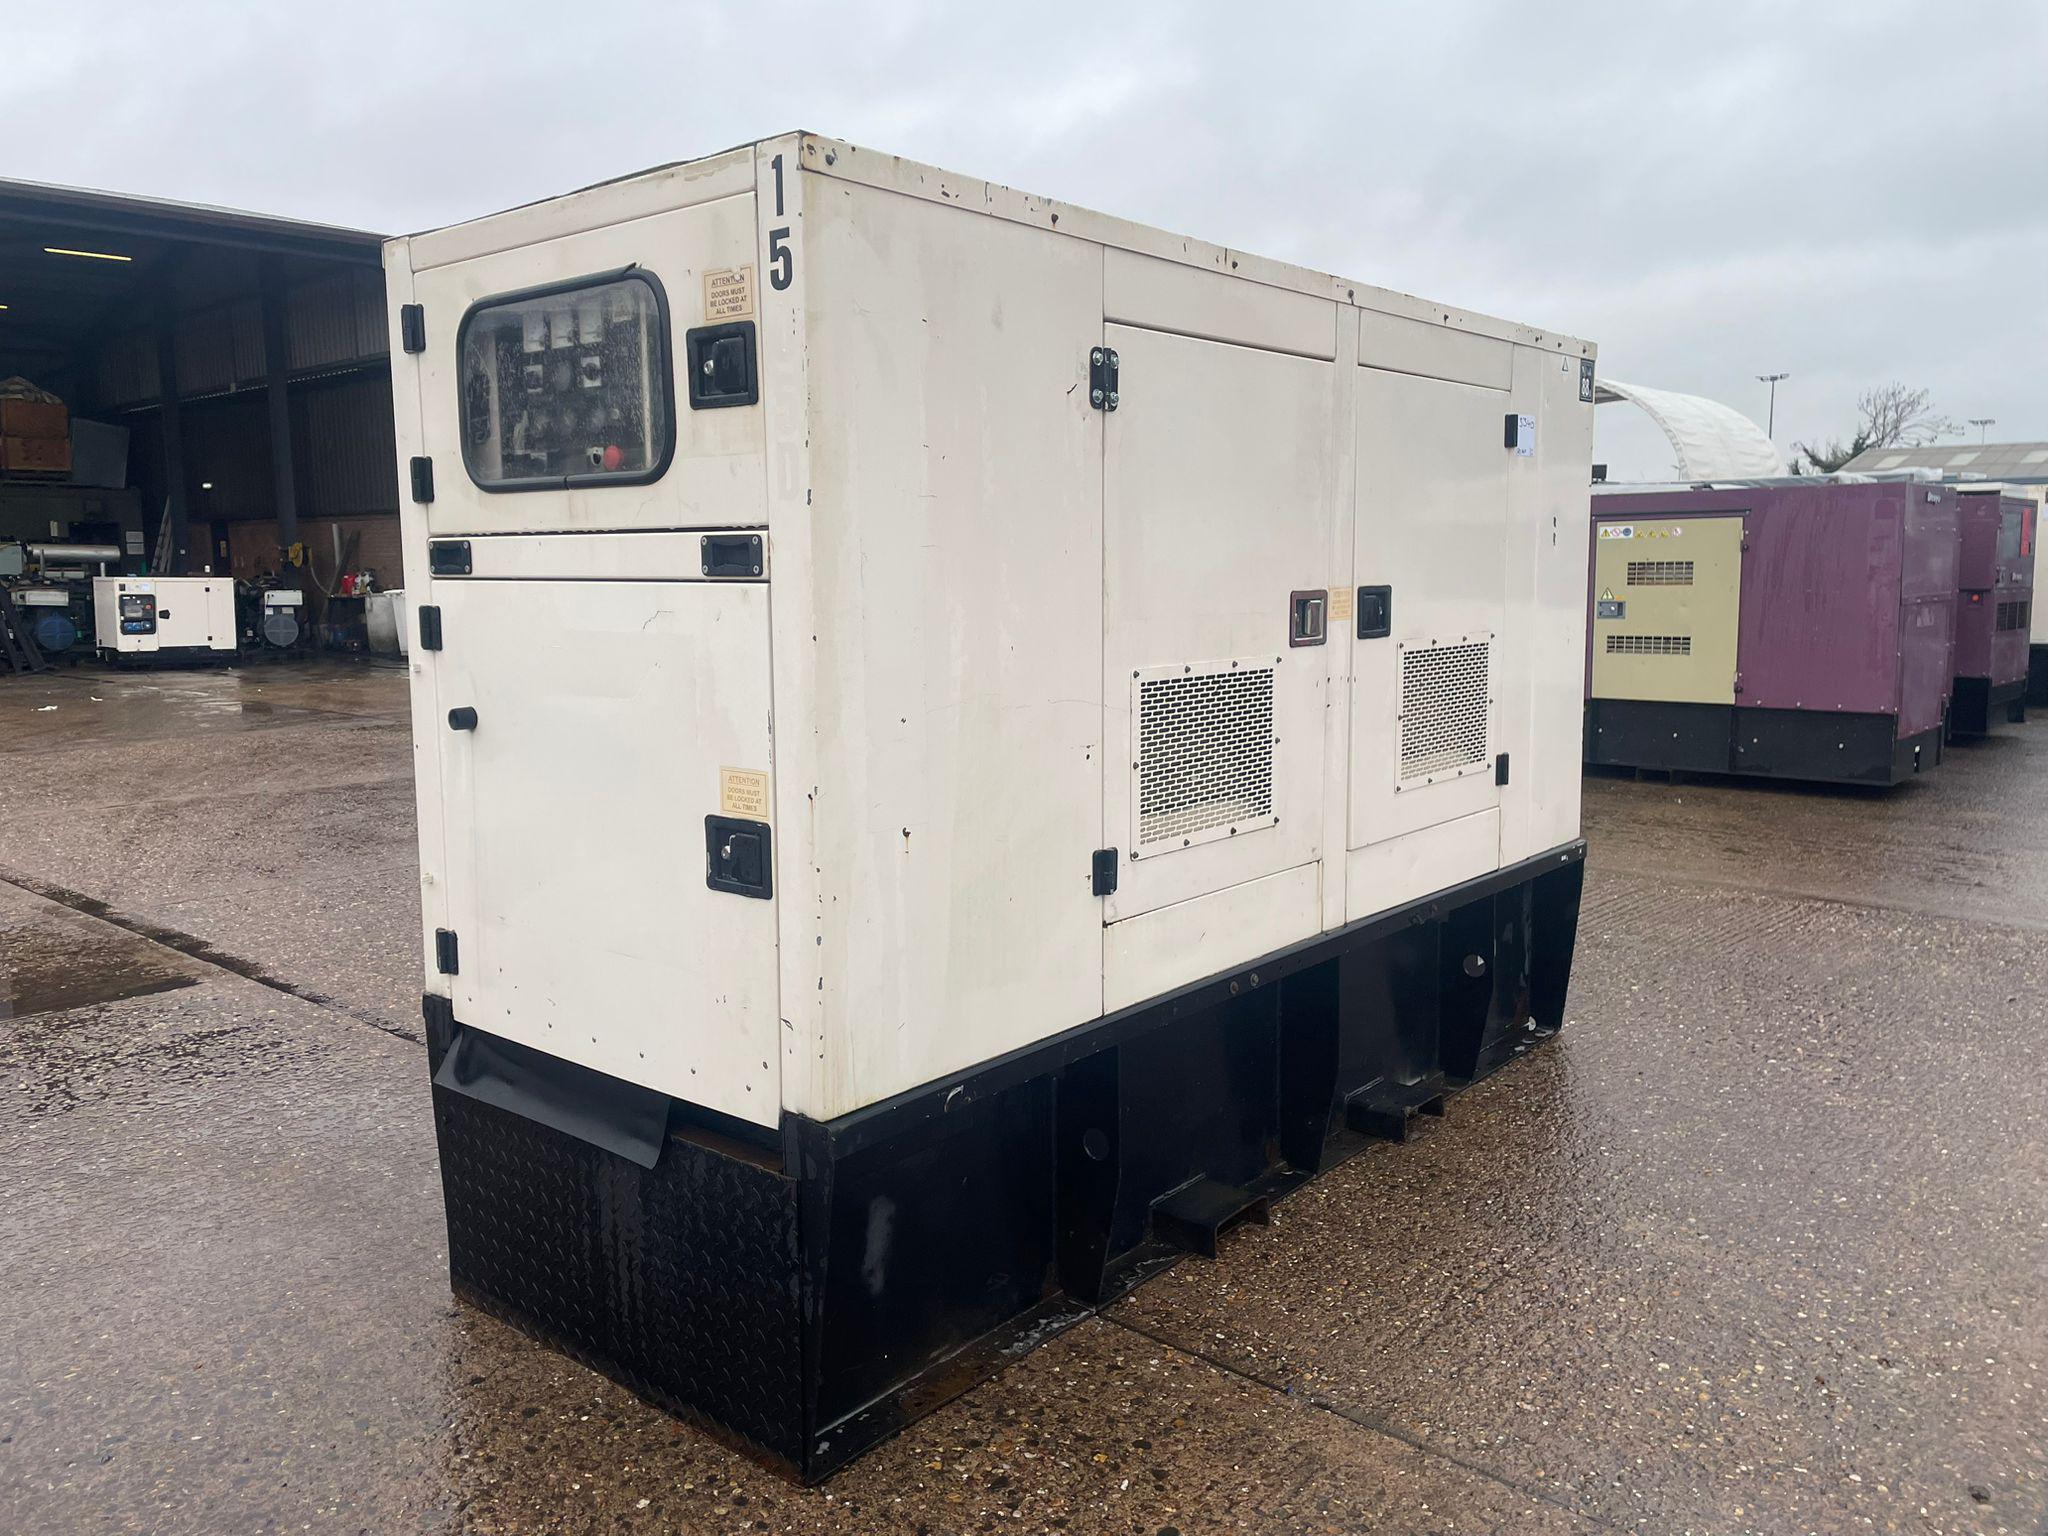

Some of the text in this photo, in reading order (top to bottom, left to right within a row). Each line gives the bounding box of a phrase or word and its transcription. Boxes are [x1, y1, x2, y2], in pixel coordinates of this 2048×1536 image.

[711, 286, 745, 299] DOORS MUST
[710, 300, 717, 308] BE
[718, 296, 740, 306] LOCKED
[726, 304, 743, 313] TIMES
[728, 776, 760, 786] ATTENTION
[734, 795, 755, 804] LOCKED
[742, 804, 758, 812] TIMES
